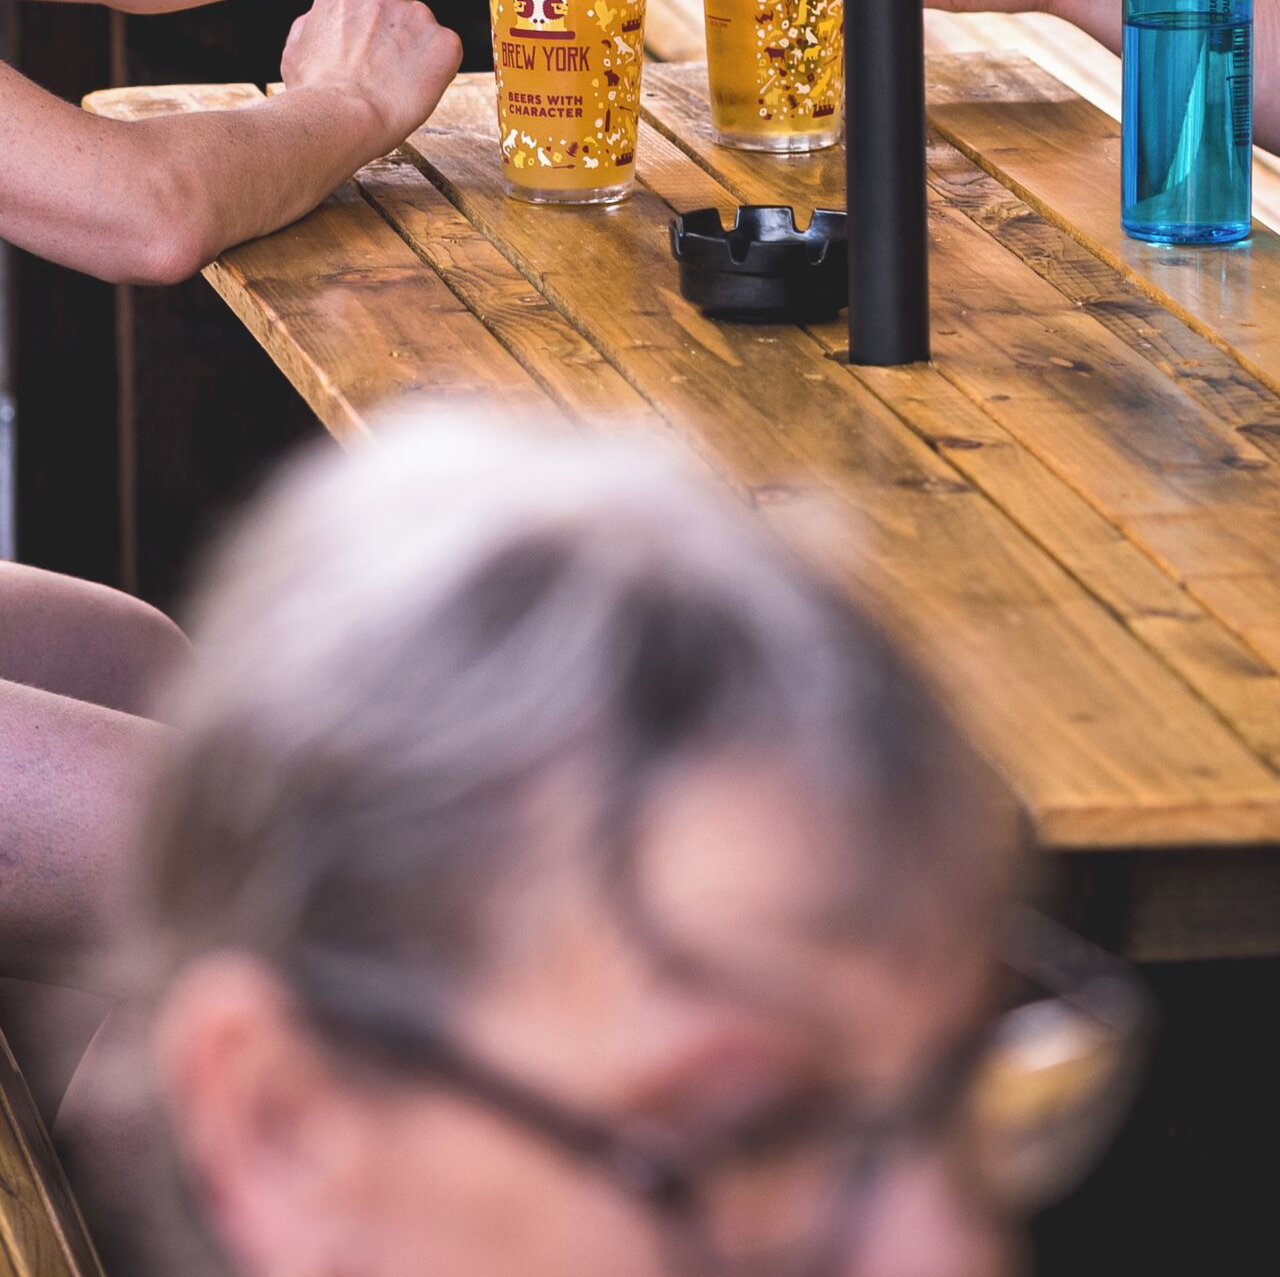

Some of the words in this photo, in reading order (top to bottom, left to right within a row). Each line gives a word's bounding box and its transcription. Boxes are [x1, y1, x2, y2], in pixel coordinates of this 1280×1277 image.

[502, 42, 536, 70] BREW
[542, 46, 590, 71] YORK
[508, 92, 542, 105] BEERS
[547, 95, 583, 106] WITH
[509, 105, 583, 118] CHARACTER
